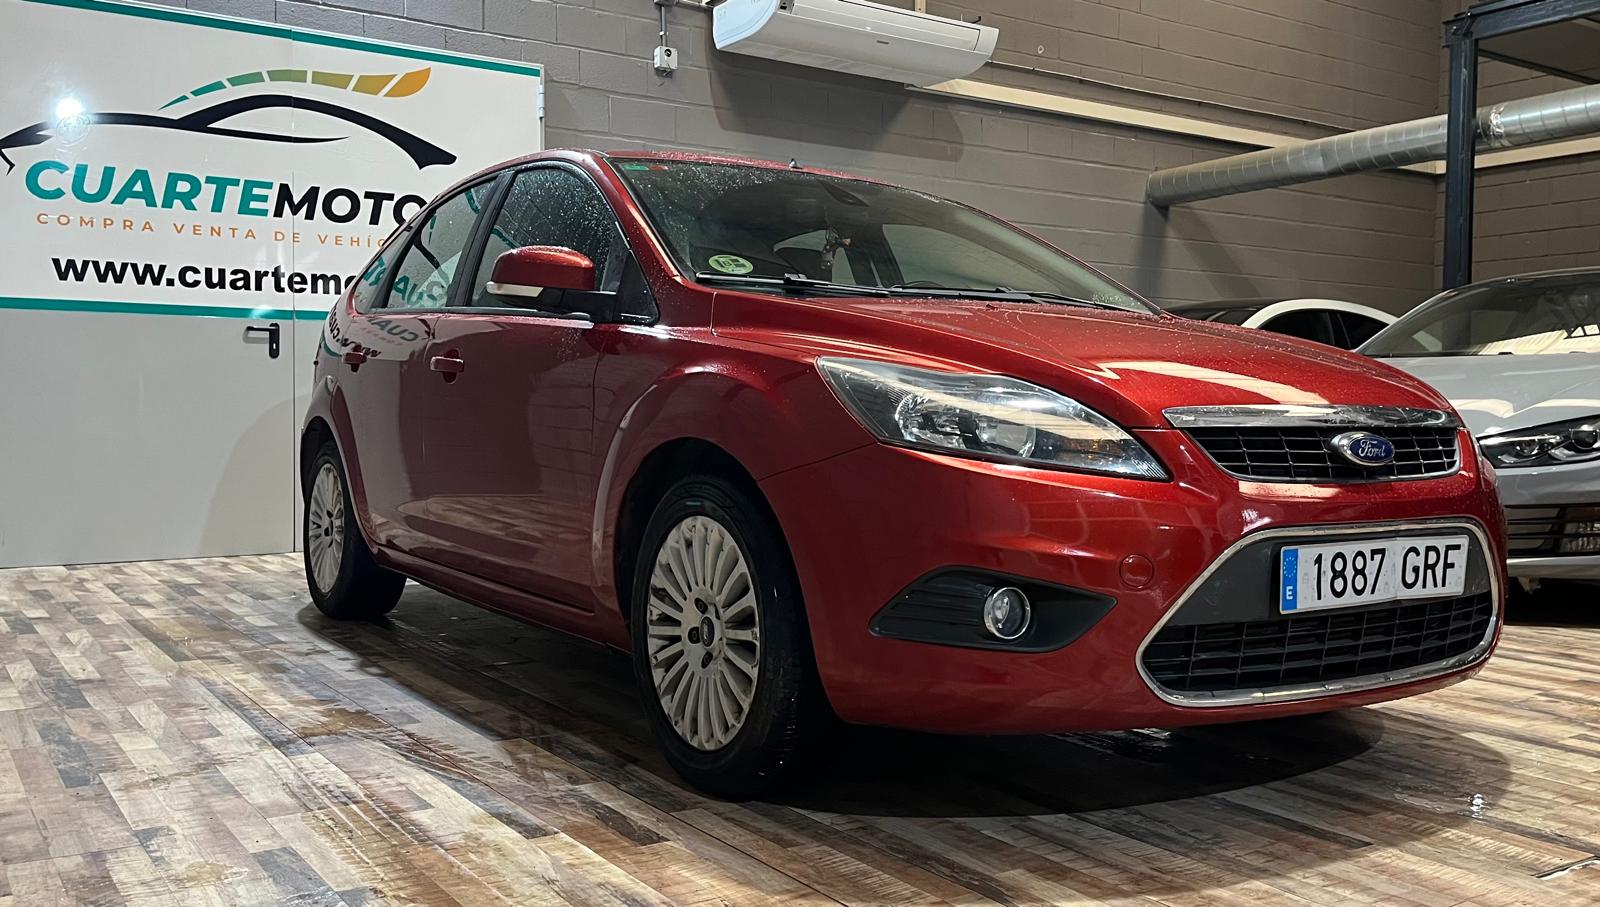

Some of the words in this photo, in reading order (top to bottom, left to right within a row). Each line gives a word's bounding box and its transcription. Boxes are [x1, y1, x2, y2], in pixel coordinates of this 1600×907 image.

[36, 212, 155, 233] COMPRA
[173, 222, 257, 240] VENTA
[274, 230, 301, 244] DE
[1358, 438, 1386, 458] Ford
[1313, 547, 1387, 601] 1887
[1401, 543, 1462, 590] GRF
[1285, 585, 1294, 600] E
